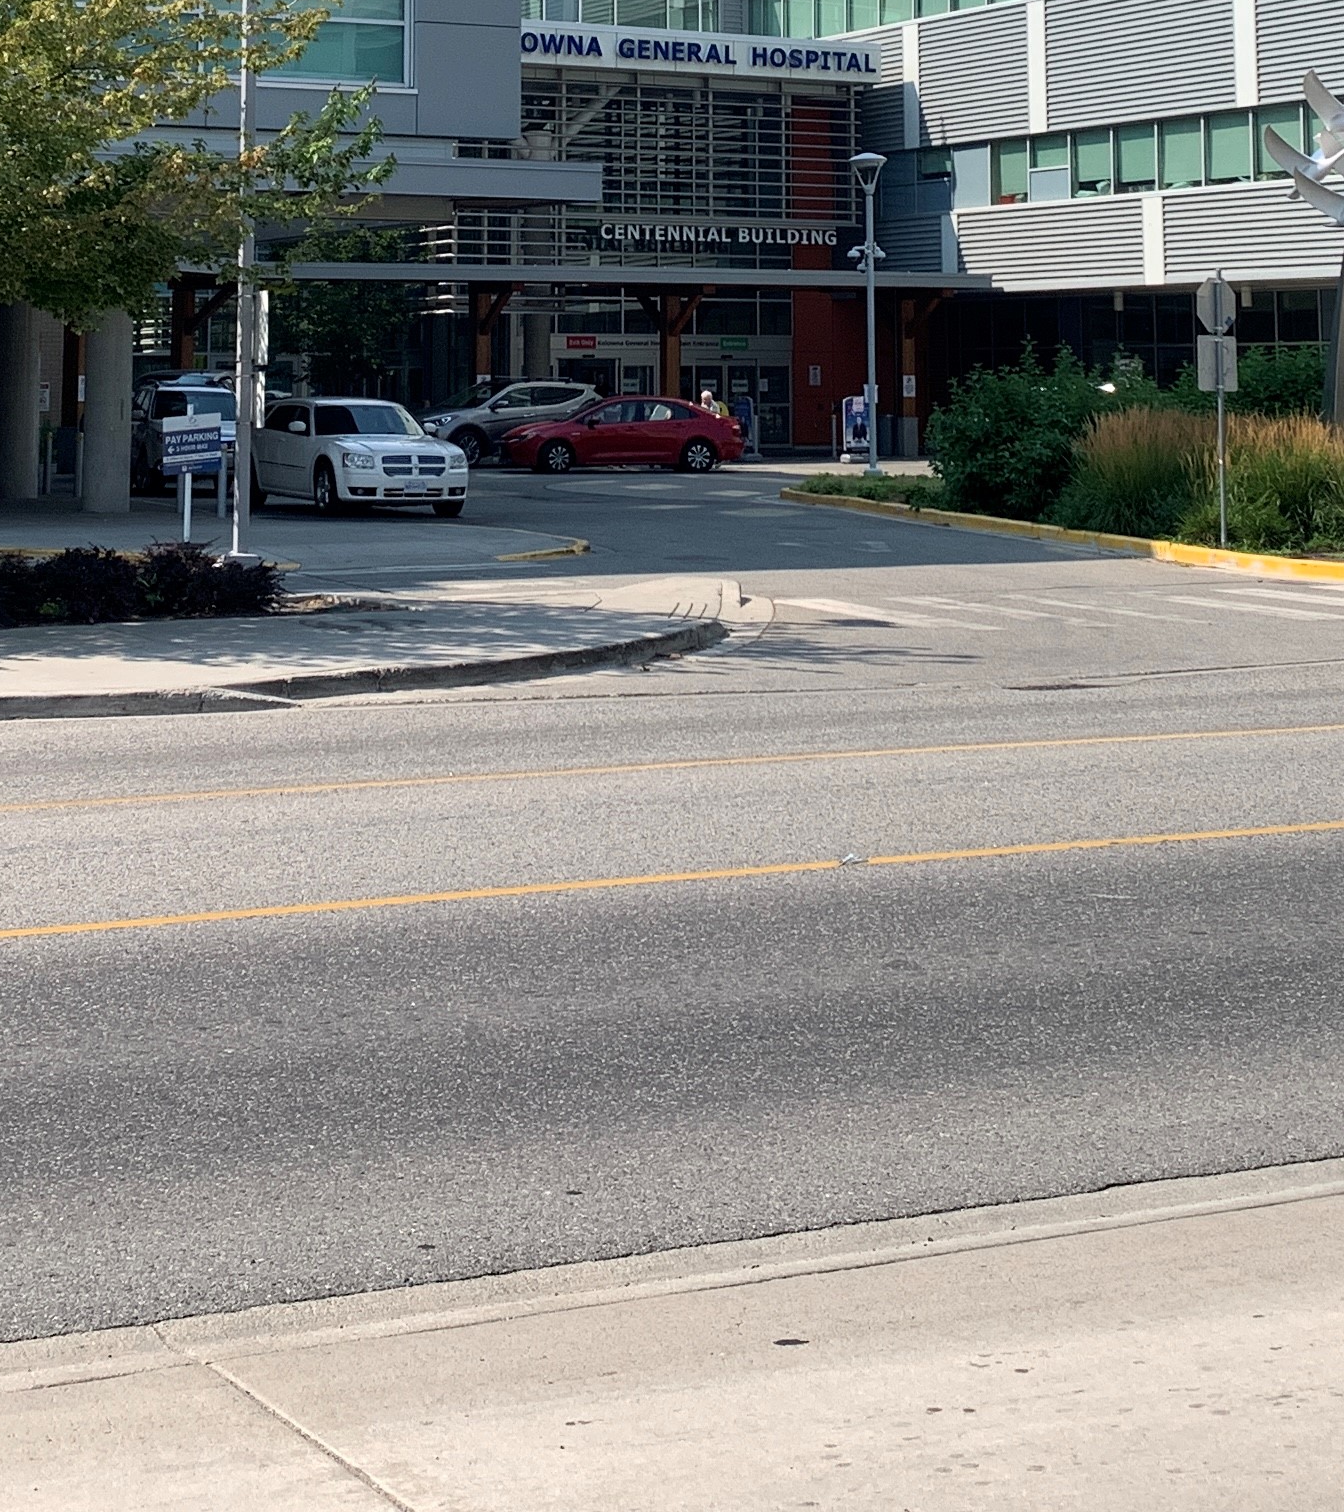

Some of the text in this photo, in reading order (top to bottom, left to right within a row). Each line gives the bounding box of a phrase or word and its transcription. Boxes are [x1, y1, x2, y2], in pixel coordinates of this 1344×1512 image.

[521, 32, 877, 73] OWNA GENERAL HOSPITAL
[600, 224, 837, 245] CENTENNIAL BUILDING
[165, 431, 219, 445] PAY PARKING
